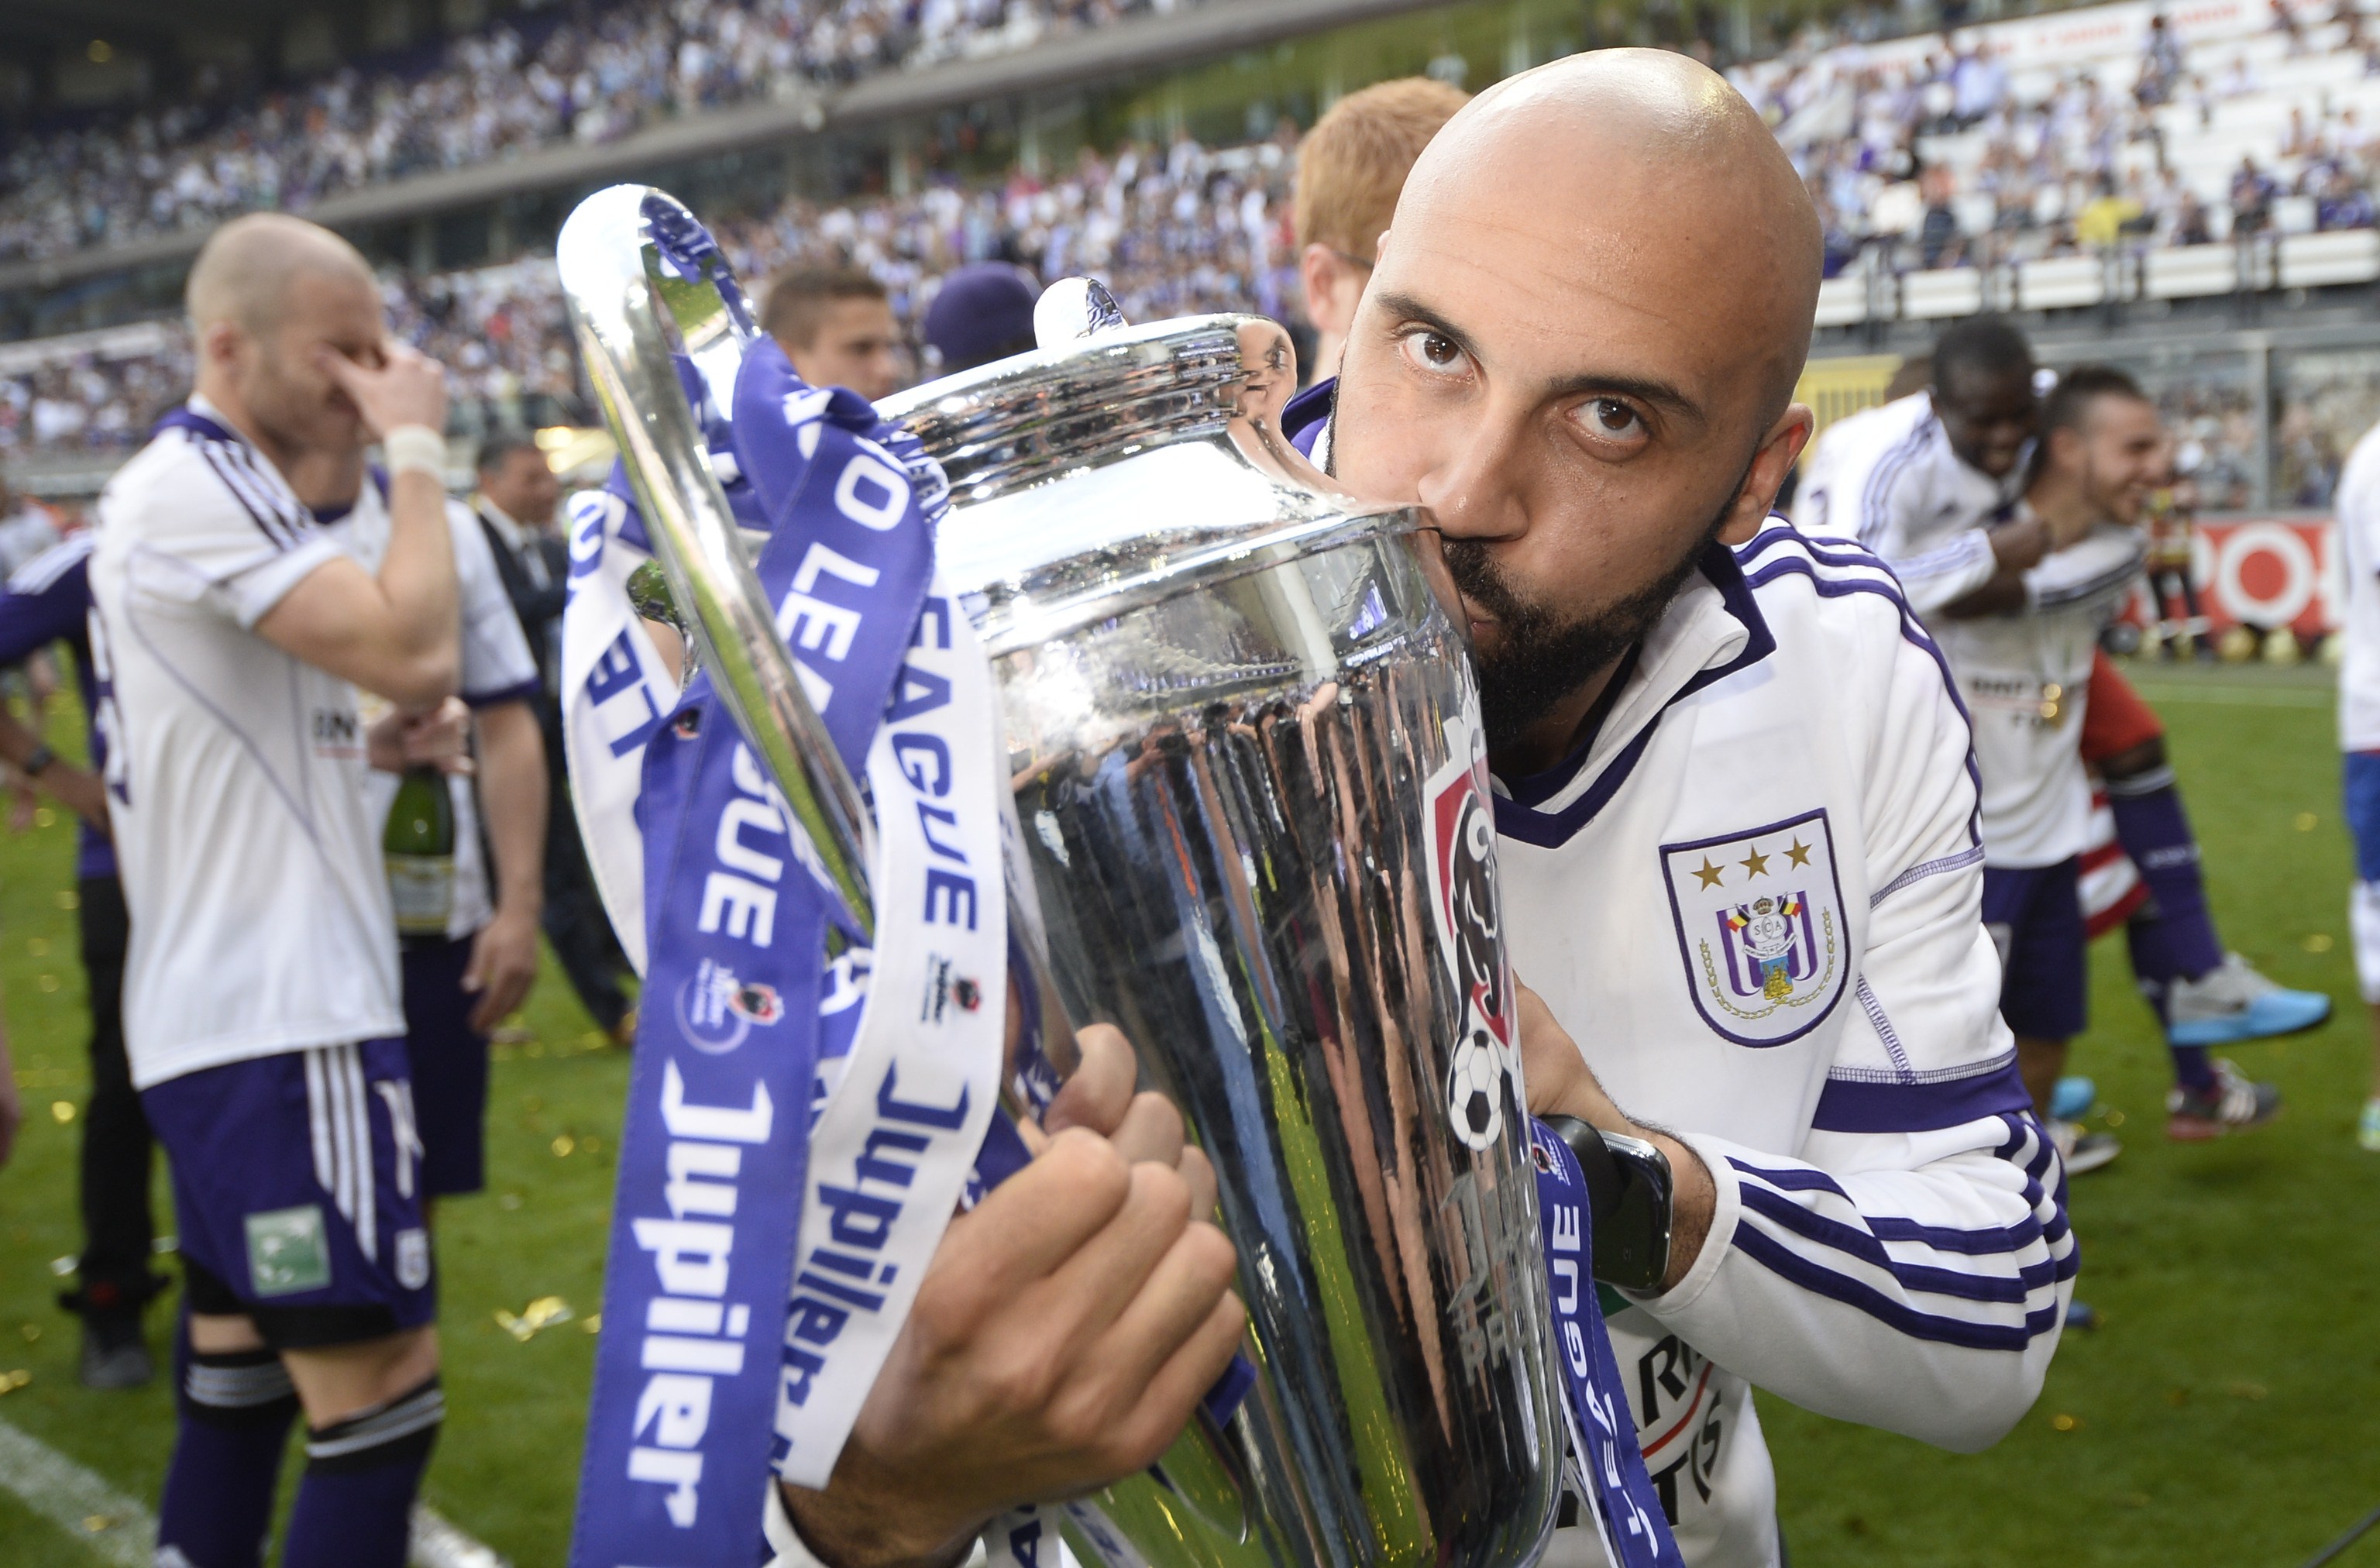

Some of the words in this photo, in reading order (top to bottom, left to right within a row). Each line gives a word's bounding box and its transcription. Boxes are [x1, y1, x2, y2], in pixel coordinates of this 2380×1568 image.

[886, 597, 977, 932] EAGUE
[628, 1057, 773, 1528] Jupiler
[781, 1057, 971, 1408] Jupiler
[1551, 1203, 1642, 1535] LEAGUE
